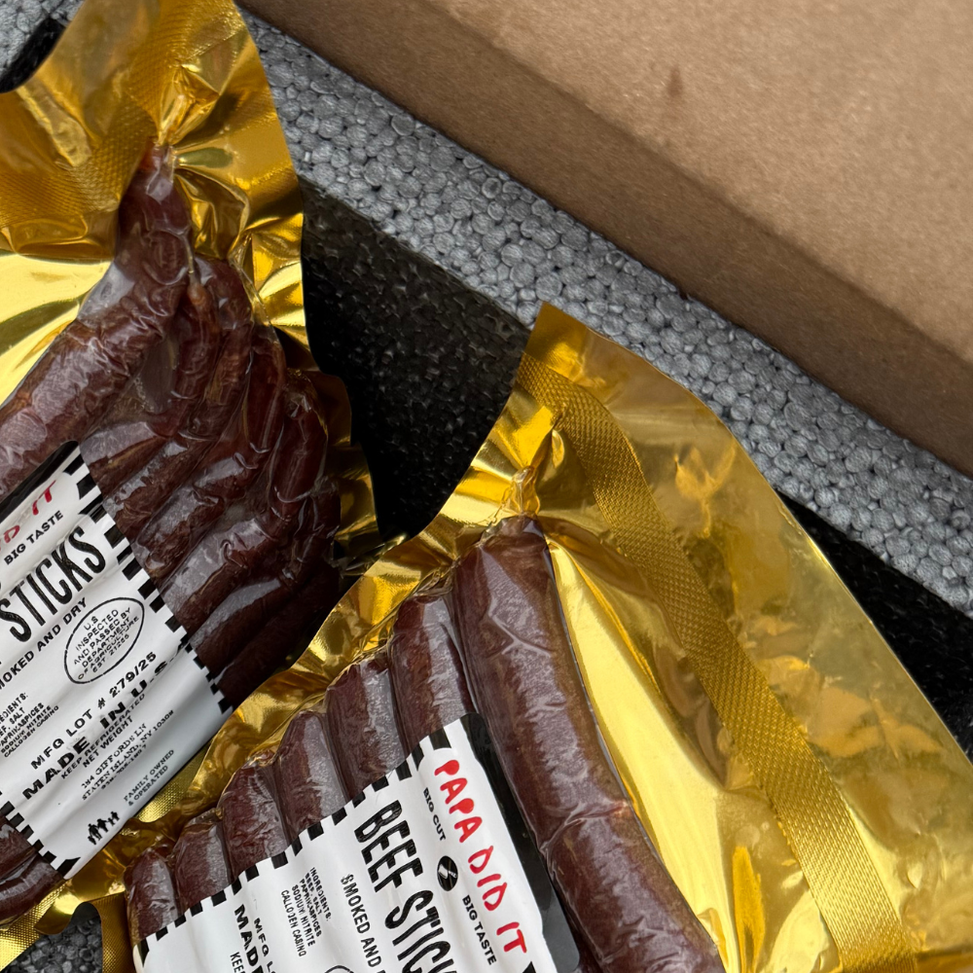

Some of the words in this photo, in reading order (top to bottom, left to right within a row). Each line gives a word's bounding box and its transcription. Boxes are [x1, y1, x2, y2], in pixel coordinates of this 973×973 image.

[28, 479, 57, 516] IT
[4, 543, 26, 565] BIG
[26, 510, 64, 544] TASTE
[37, 624, 61, 652] AND
[62, 597, 86, 625] DRY
[74, 648, 90, 665] AND
[89, 618, 120, 649] PASSED
[120, 607, 130, 619] BY
[75, 609, 119, 651] INSPECTED
[9, 707, 25, 725] SALT
[26, 705, 52, 730] NITRITE
[30, 738, 65, 770] MFG
[66, 708, 92, 737] LOT
[95, 697, 107, 709] #
[82, 747, 99, 768] NET
[100, 715, 133, 749] WEIGHT
[140, 730, 153, 743] NY
[22, 736, 91, 800] MADE
[100, 701, 126, 729] IN
[61, 756, 82, 779] KEEP
[123, 774, 149, 802] FAMILY
[149, 749, 174, 775] OWNED
[423, 787, 434, 813] BIG
[433, 814, 446, 841] CUT
[354, 799, 424, 893] BEEF
[434, 759, 483, 843] PAPA
[467, 845, 507, 911] DID
[496, 922, 527, 953] IT
[291, 884, 306, 915] SODIUM
[300, 915, 316, 947] NITRITE
[313, 896, 322, 915] SALT
[340, 874, 370, 934] SMOKED
[360, 937, 382, 968] AND
[462, 894, 478, 921] BIG
[474, 921, 497, 965] TASTE
[254, 917, 269, 957] MFG
